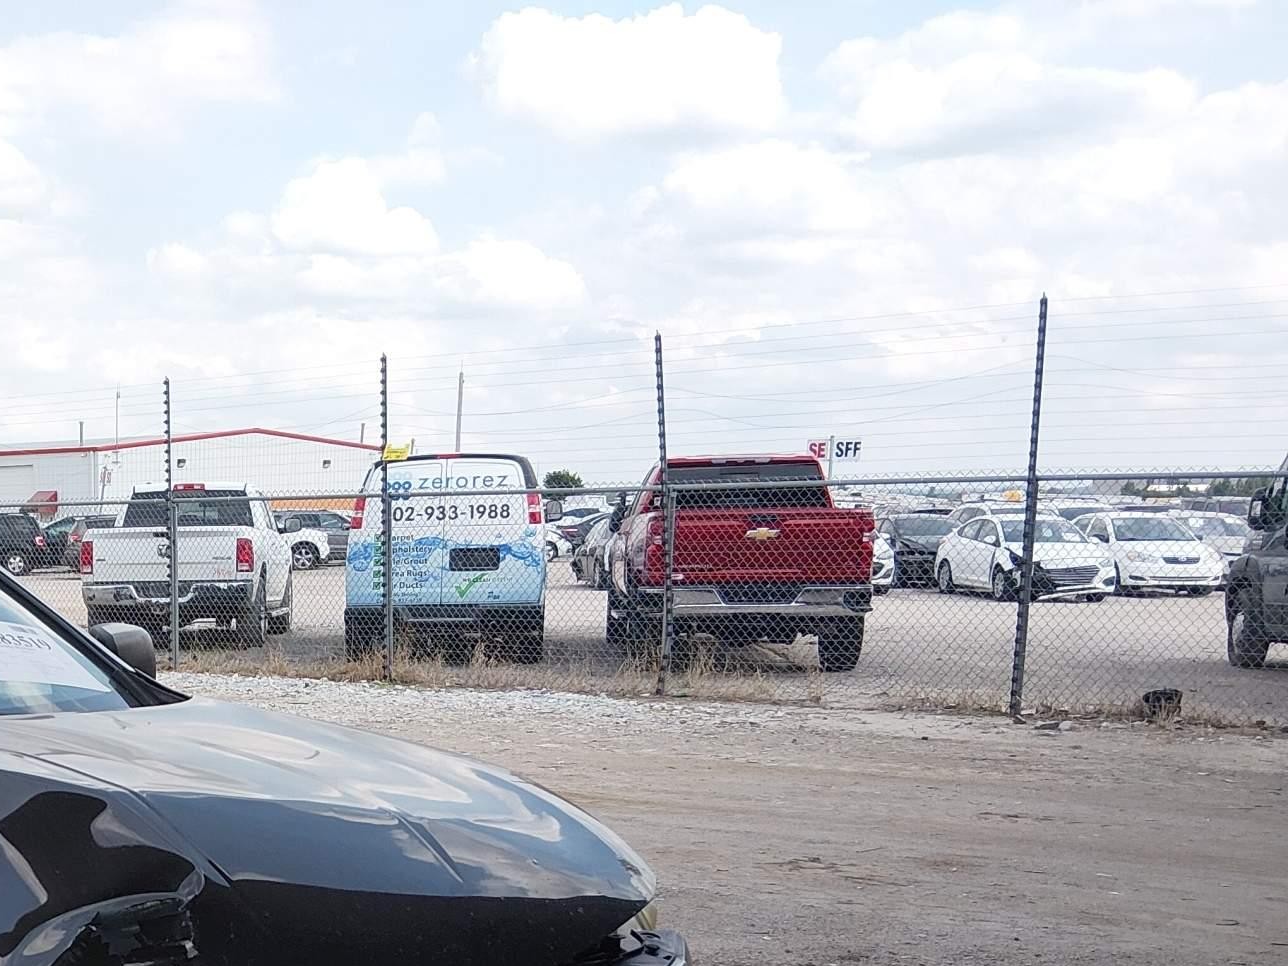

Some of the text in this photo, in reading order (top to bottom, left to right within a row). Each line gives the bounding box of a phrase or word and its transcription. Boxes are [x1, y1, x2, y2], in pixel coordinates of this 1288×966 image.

[835, 441, 862, 457] SFF
[419, 475, 509, 490] zerorez
[393, 503, 510, 522] 02-933-1988
[392, 535, 414, 543] arpet
[392, 545, 433, 554] pholstery
